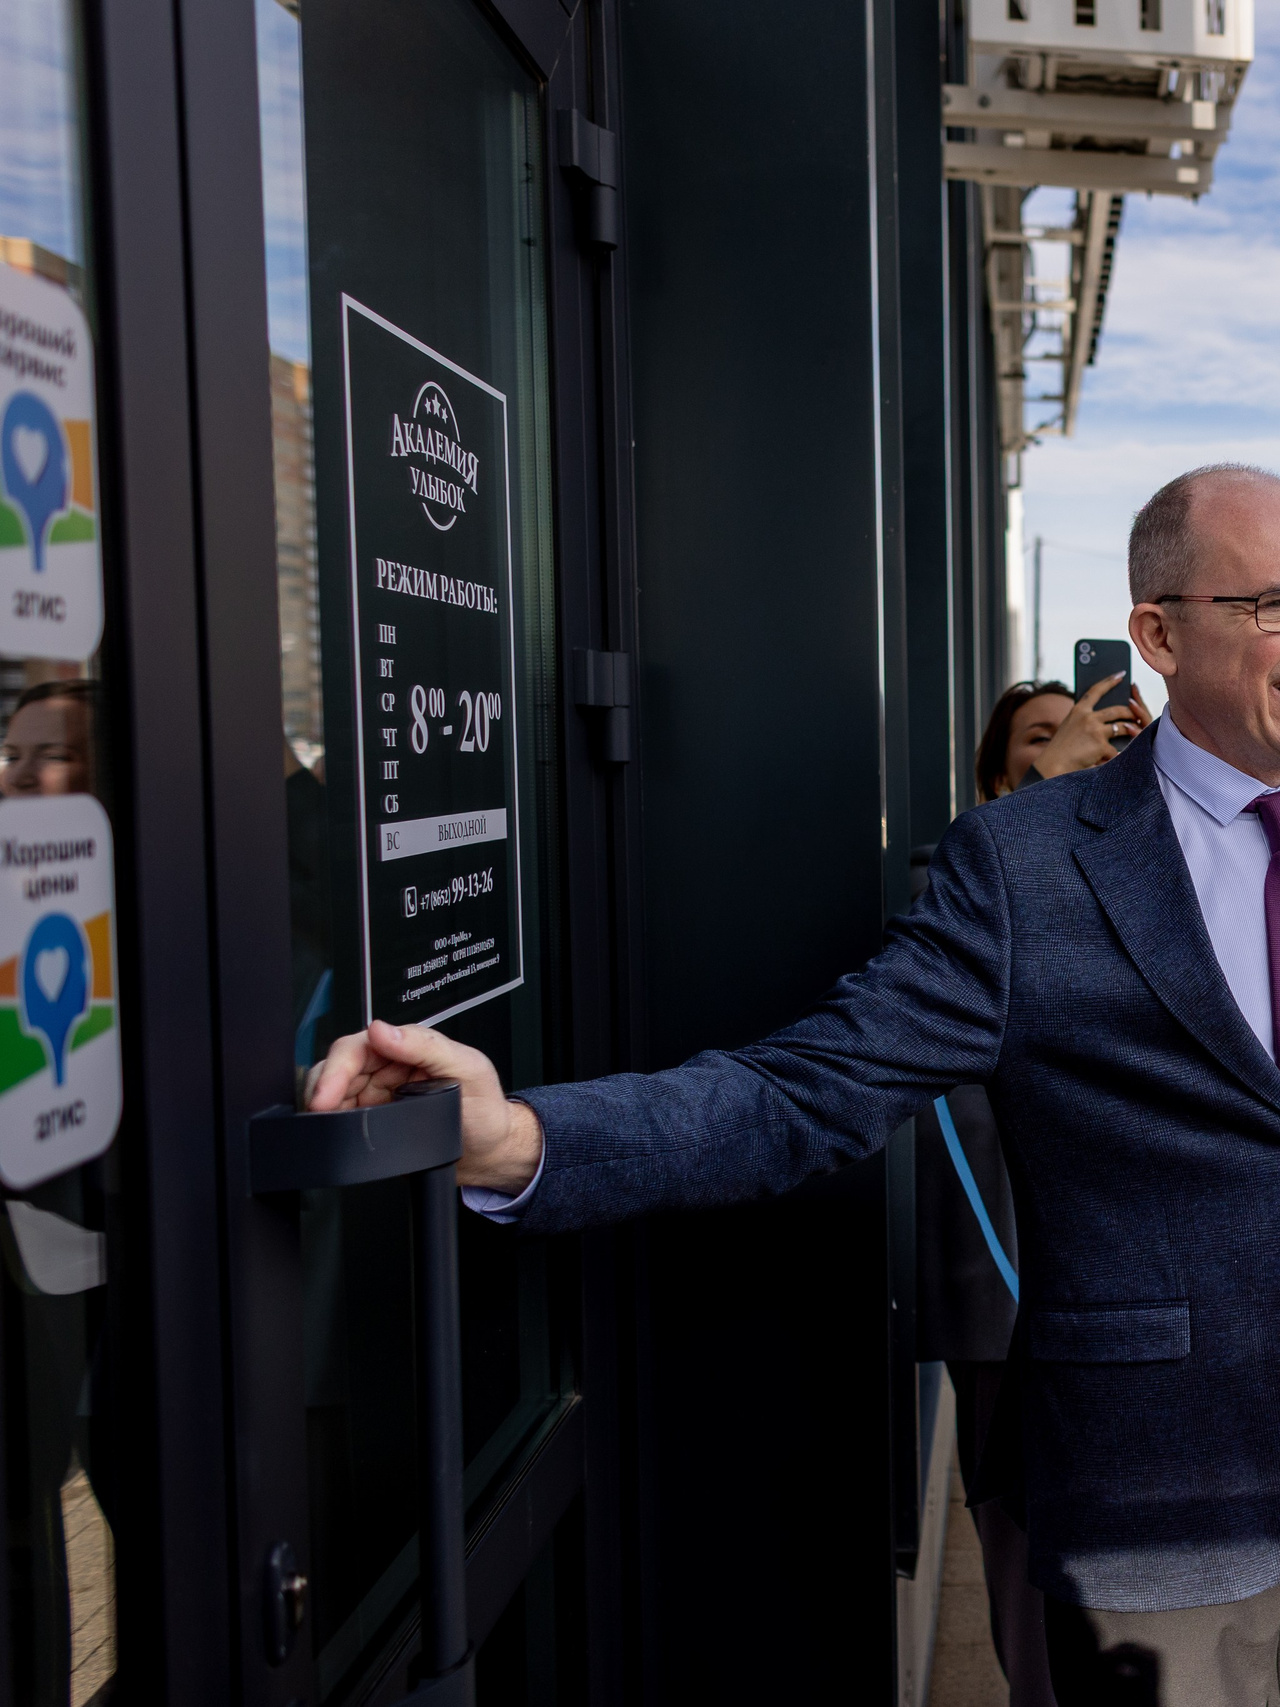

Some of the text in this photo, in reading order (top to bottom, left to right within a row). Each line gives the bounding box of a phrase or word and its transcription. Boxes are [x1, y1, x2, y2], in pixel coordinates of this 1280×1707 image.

[0, 307, 76, 358] ороший
[391, 413, 479, 495] АКАДЕМИЯ
[410, 466, 466, 513] УЛЫБОК
[376, 557, 498, 614] РЕЖИМ РАБОТЫ:
[379, 623, 397, 645] ПН
[380, 658, 394, 678] ВТ
[381, 692, 396, 712] СР
[382, 728, 398, 747] ЧТ
[384, 760, 400, 780] ПТ
[384, 794, 399, 814] СБ
[386, 815, 487, 851] ВС ВЫХОДНОЙ
[2, 837, 96, 872] Хорошие
[24, 873, 79, 902] цены
[430, 886, 451, 911] (8652)
[452, 866, 493, 904] 99-13-26
